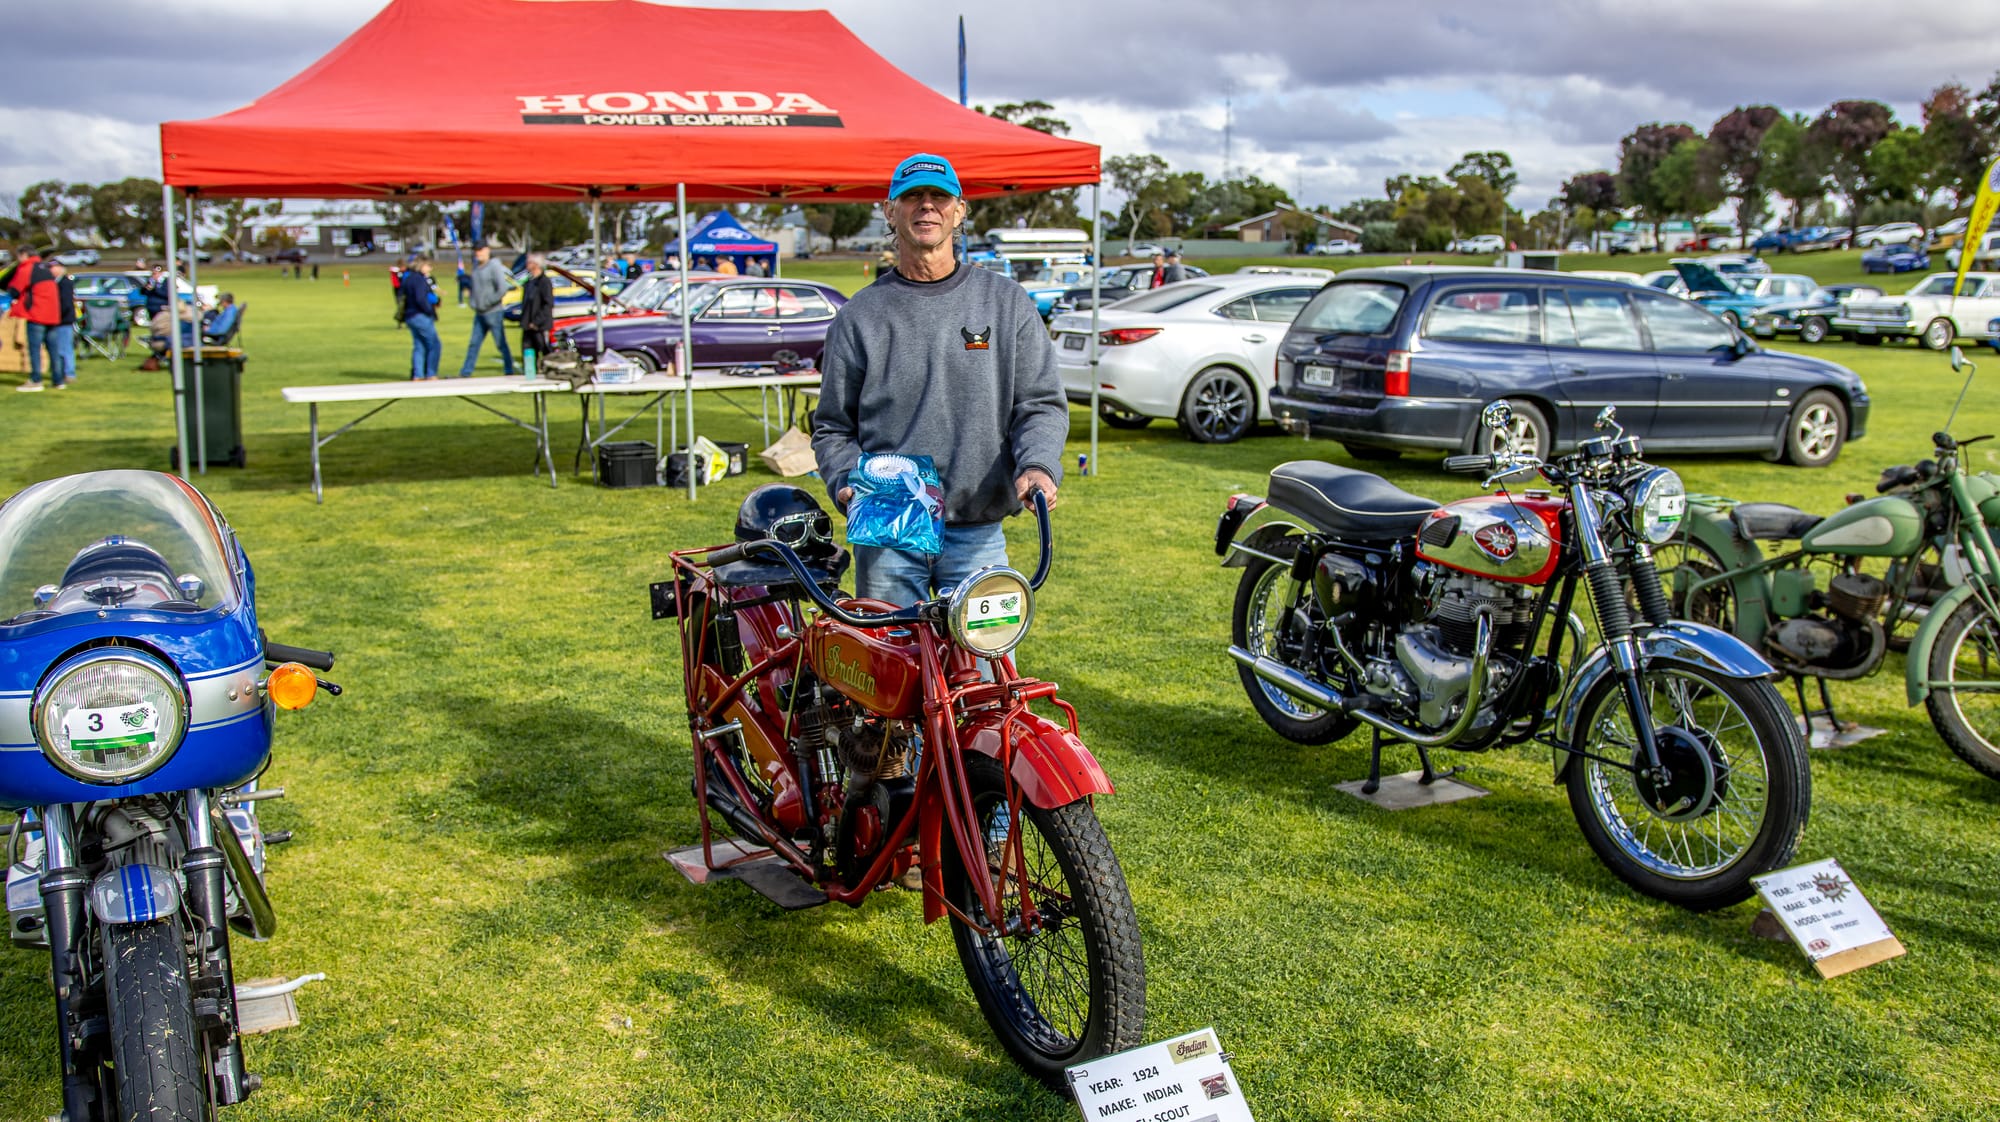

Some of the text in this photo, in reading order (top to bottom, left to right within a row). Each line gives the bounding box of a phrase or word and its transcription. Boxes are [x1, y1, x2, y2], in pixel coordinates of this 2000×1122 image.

[516, 91, 838, 113] HONDA
[583, 114, 788, 126] POWER EQUIPMENT
[1667, 500, 1674, 511] 4
[980, 600, 990, 615] 6
[825, 645, 876, 696] Indian
[88, 713, 104, 732] 3
[1772, 887, 1793, 897] YEAR:
[1783, 901, 1807, 912] MAKE:
[1795, 915, 1822, 926] MODEL:
[1176, 1040, 1208, 1056] Indian
[1088, 1065, 1160, 1095] YEAR: 1924
[1098, 1083, 1183, 1118] MAKE: INDIAN
[1154, 1105, 1190, 1122] SCOUT
